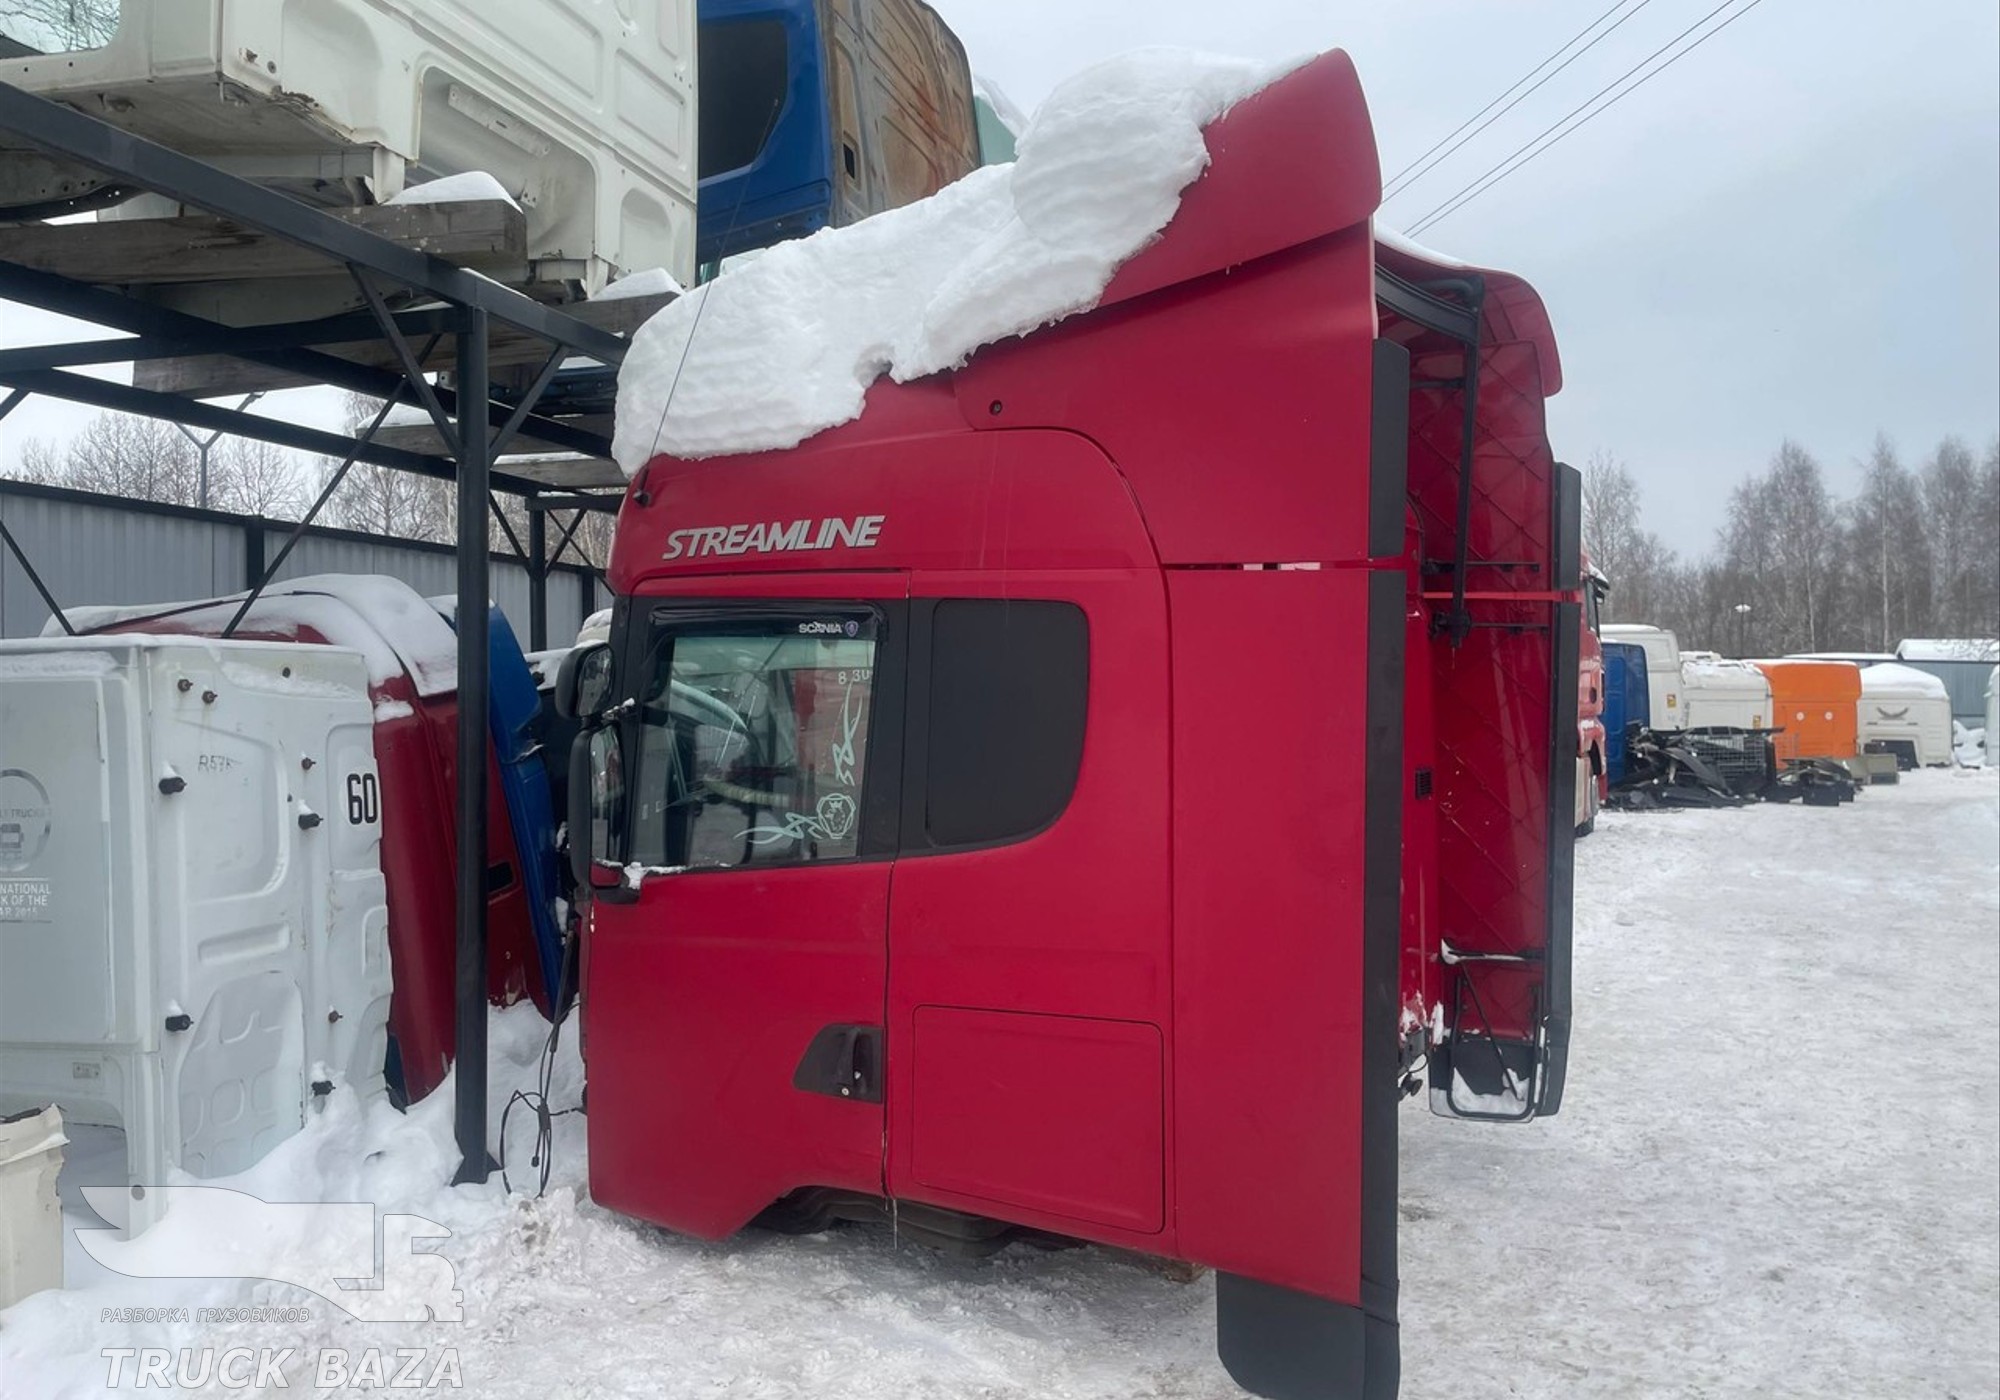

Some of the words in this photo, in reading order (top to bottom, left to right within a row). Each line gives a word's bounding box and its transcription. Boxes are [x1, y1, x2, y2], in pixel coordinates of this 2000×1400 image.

[662, 515, 885, 560] STREAMLINE
[798, 621, 842, 634] SCANIA
[347, 772, 378, 825] 60
[11, 894, 24, 906] OF
[28, 894, 49, 906] THE
